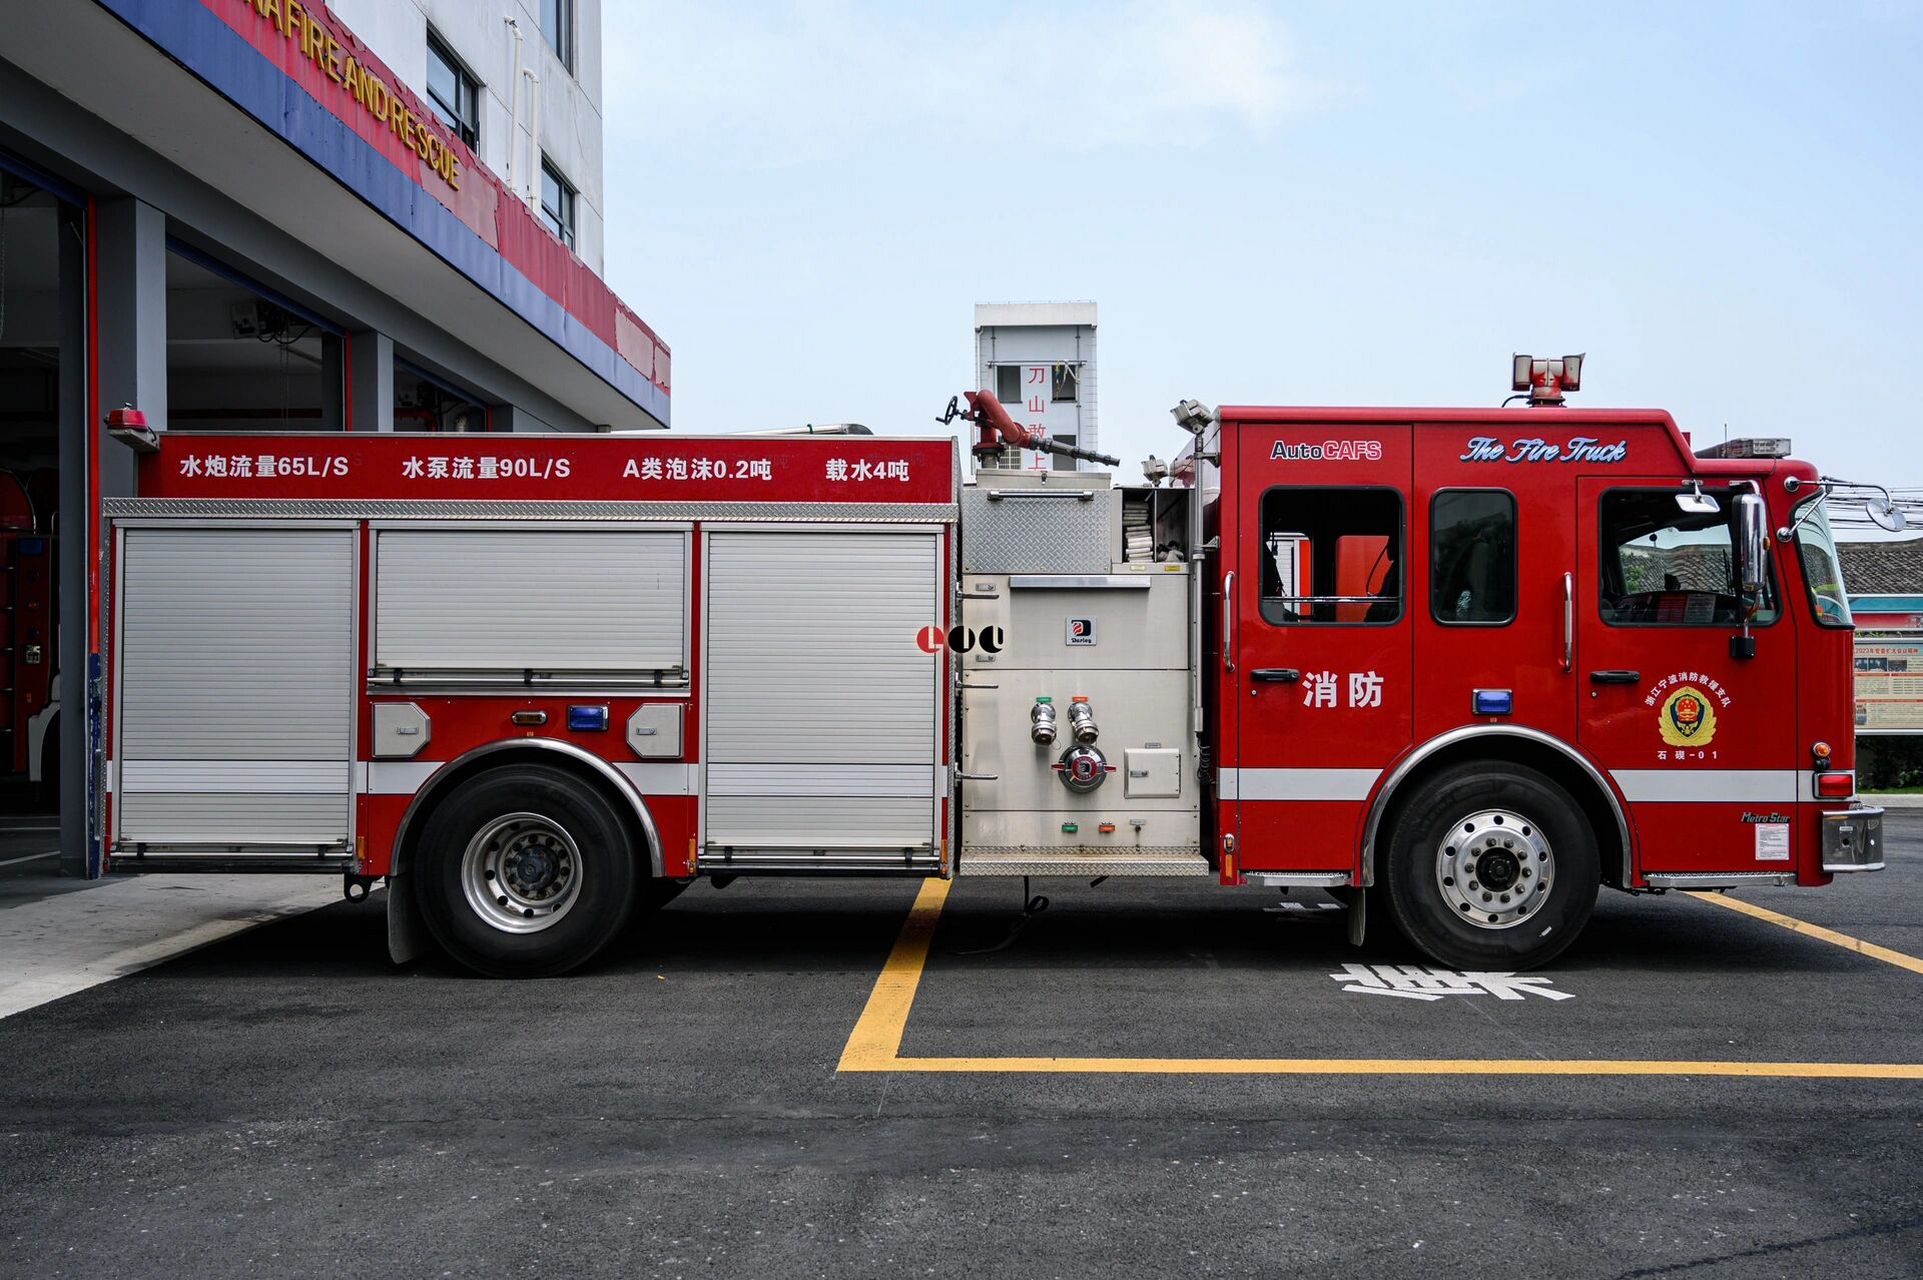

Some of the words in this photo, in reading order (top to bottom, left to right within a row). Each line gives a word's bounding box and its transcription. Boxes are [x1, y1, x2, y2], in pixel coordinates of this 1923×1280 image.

[284, 0, 341, 84] FIRE
[343, 56, 388, 122] AND
[388, 98, 461, 191] RESCUE
[1270, 440, 1382, 461] AutoCAFS
[1460, 437, 1505, 463] The
[1506, 439, 1560, 463] Fire
[1560, 437, 1628, 463] Truck
[180, 455, 349, 478] 水炮流量65L/S
[402, 456, 571, 480] 水泵流量90L/S
[623, 458, 772, 481] A类泡沫0.2吨
[825, 458, 910, 482] 载水4吨
[1302, 671, 1384, 708] 消防
